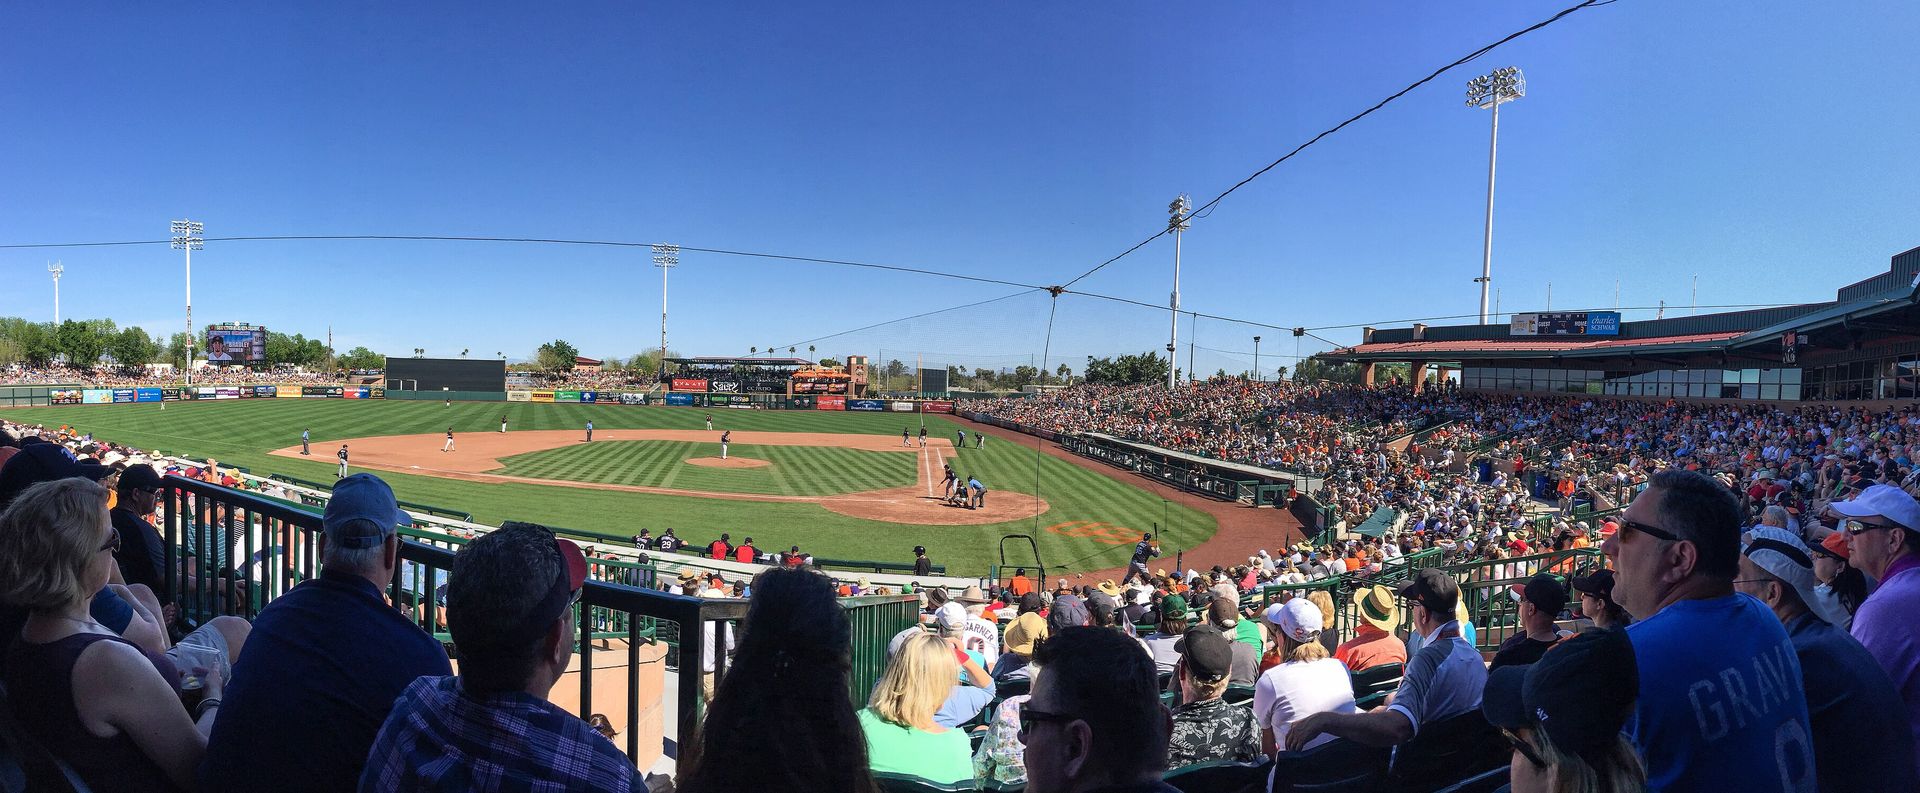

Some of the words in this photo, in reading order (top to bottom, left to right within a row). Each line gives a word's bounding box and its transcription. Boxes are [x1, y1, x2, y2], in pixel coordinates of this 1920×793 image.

[1591, 315, 1615, 324] charles
[661, 540, 672, 549] 29
[963, 621, 994, 642] GARNER
[1687, 640, 1800, 745] GRAV
